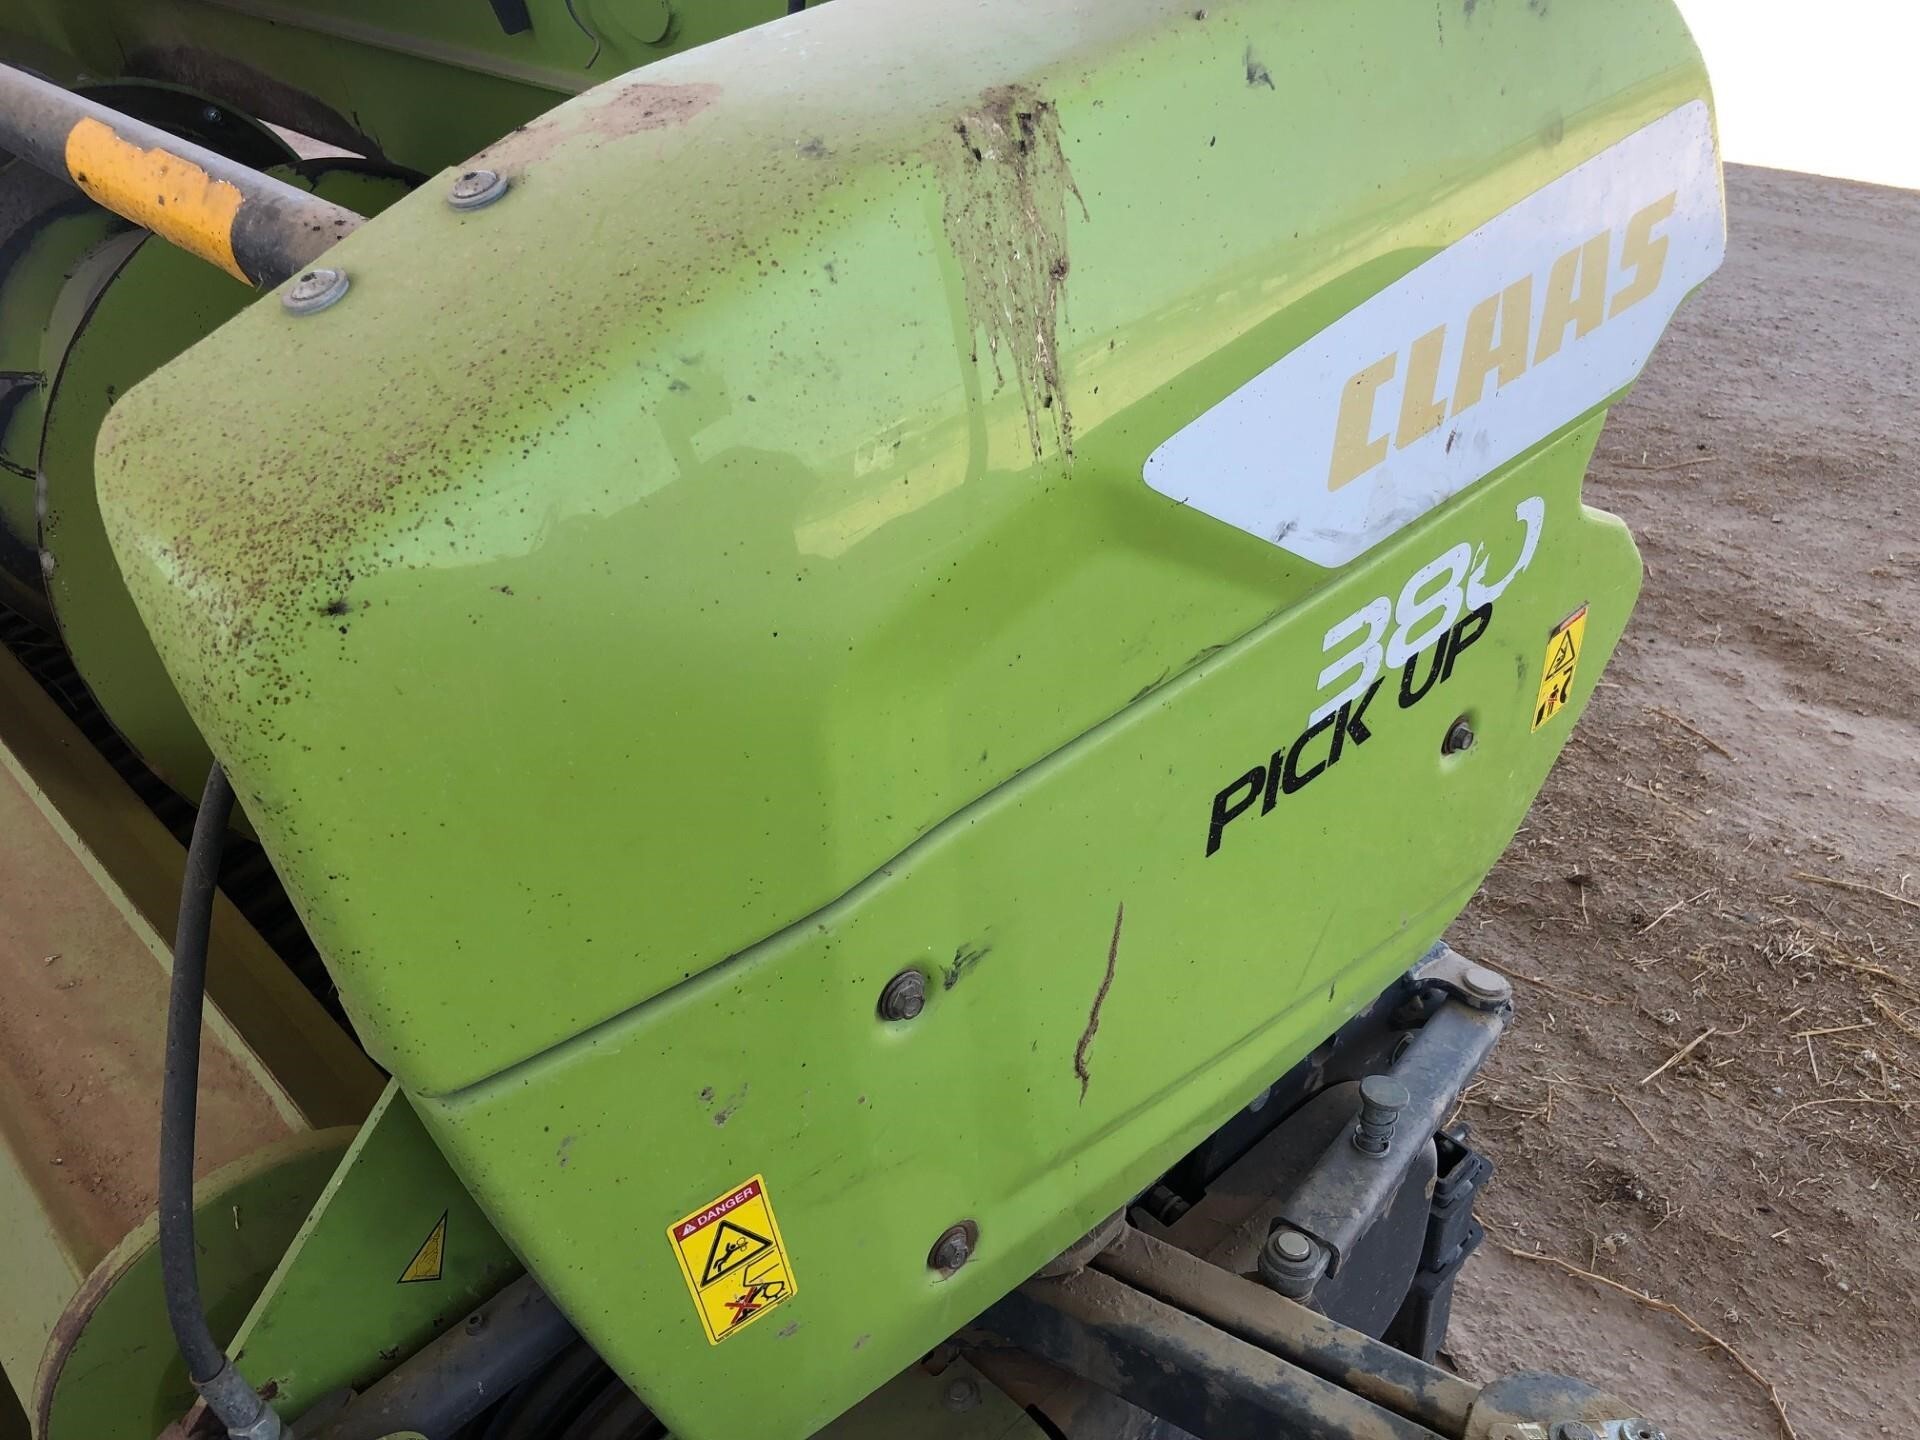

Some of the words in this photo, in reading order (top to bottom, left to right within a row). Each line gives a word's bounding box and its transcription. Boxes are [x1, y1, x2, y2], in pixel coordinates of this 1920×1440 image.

[1327, 190, 1677, 492] CLAAS
[1206, 675, 1385, 857] PICK
[1398, 602, 1493, 708] UP
[697, 1187, 753, 1226] DANGER
